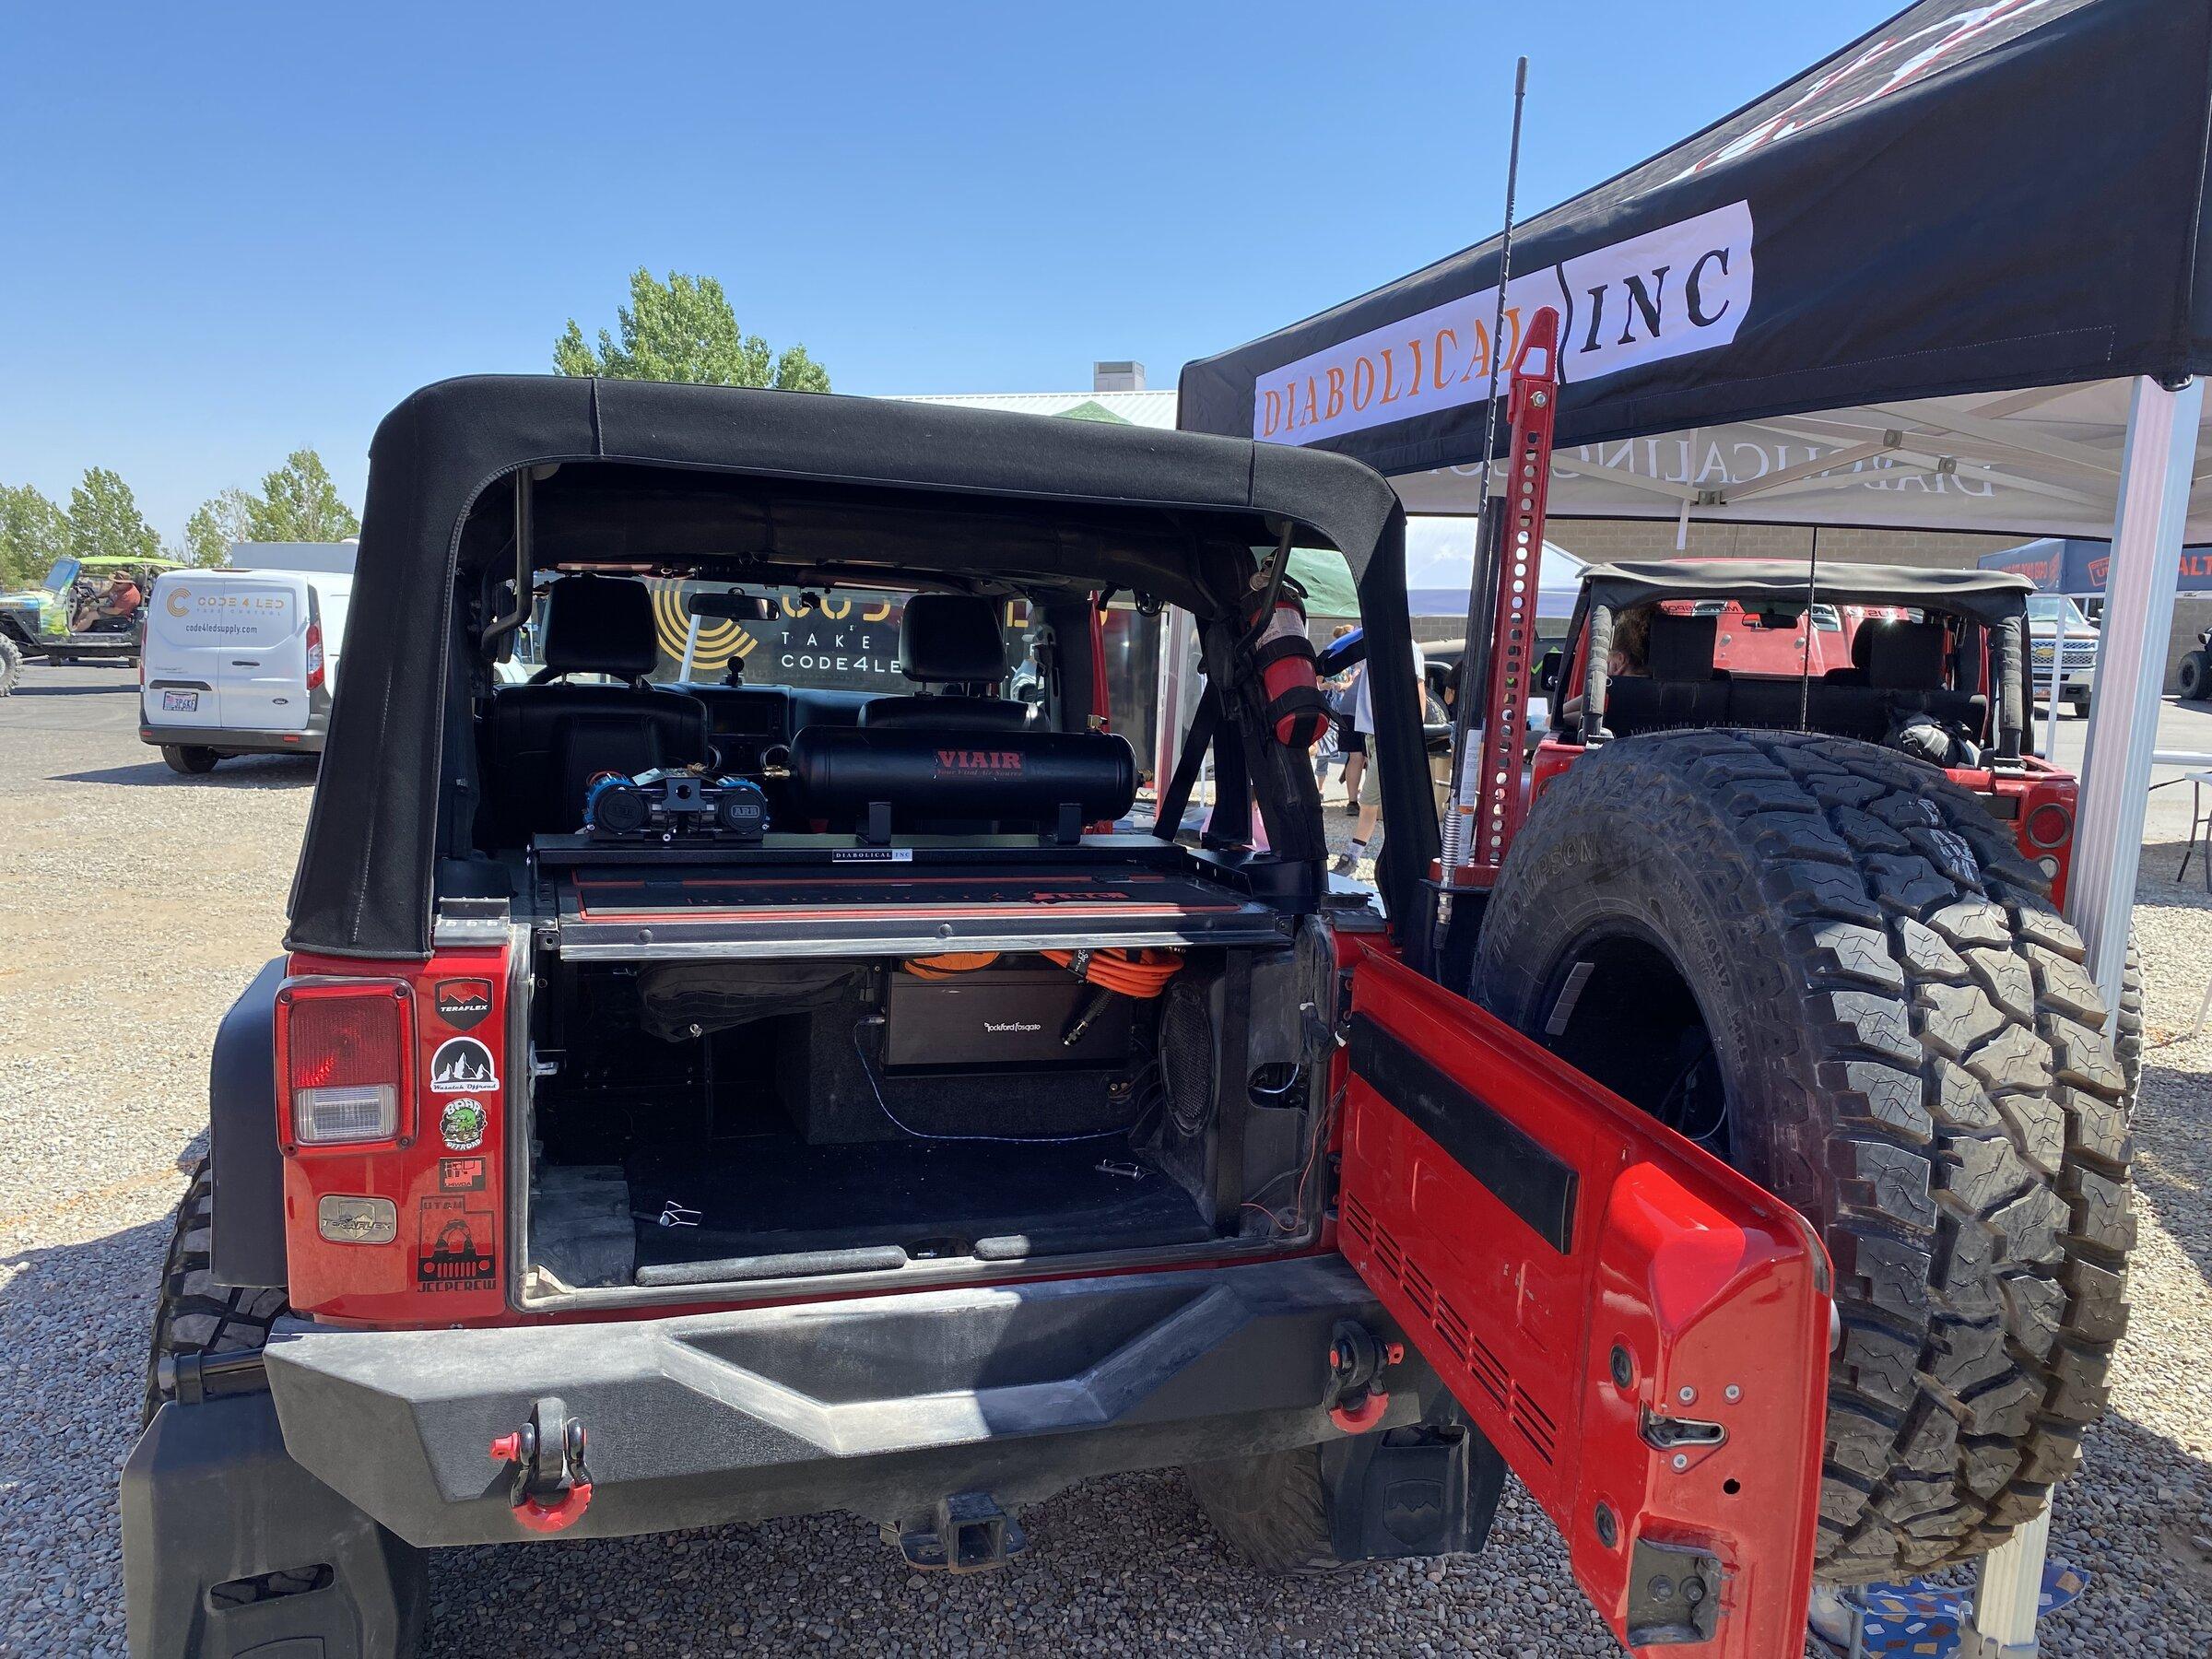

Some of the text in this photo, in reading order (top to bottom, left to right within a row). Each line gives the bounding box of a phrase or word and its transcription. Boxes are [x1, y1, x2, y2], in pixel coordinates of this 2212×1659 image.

[1580, 247, 1730, 354] INC
[197, 596, 238, 607] CODE
[255, 598, 285, 609] LED
[185, 623, 258, 635] code4ledsupply.com
[782, 631, 870, 649] TAKE
[781, 654, 902, 674] CODE4LE
[937, 750, 1021, 769] VIAIR
[1486, 831, 1599, 968] THOMPSON
[440, 1004, 488, 1013] TERAFLEX
[445, 1138, 482, 1151] OFFROAD
[322, 1218, 394, 1232] TERAFLEX
